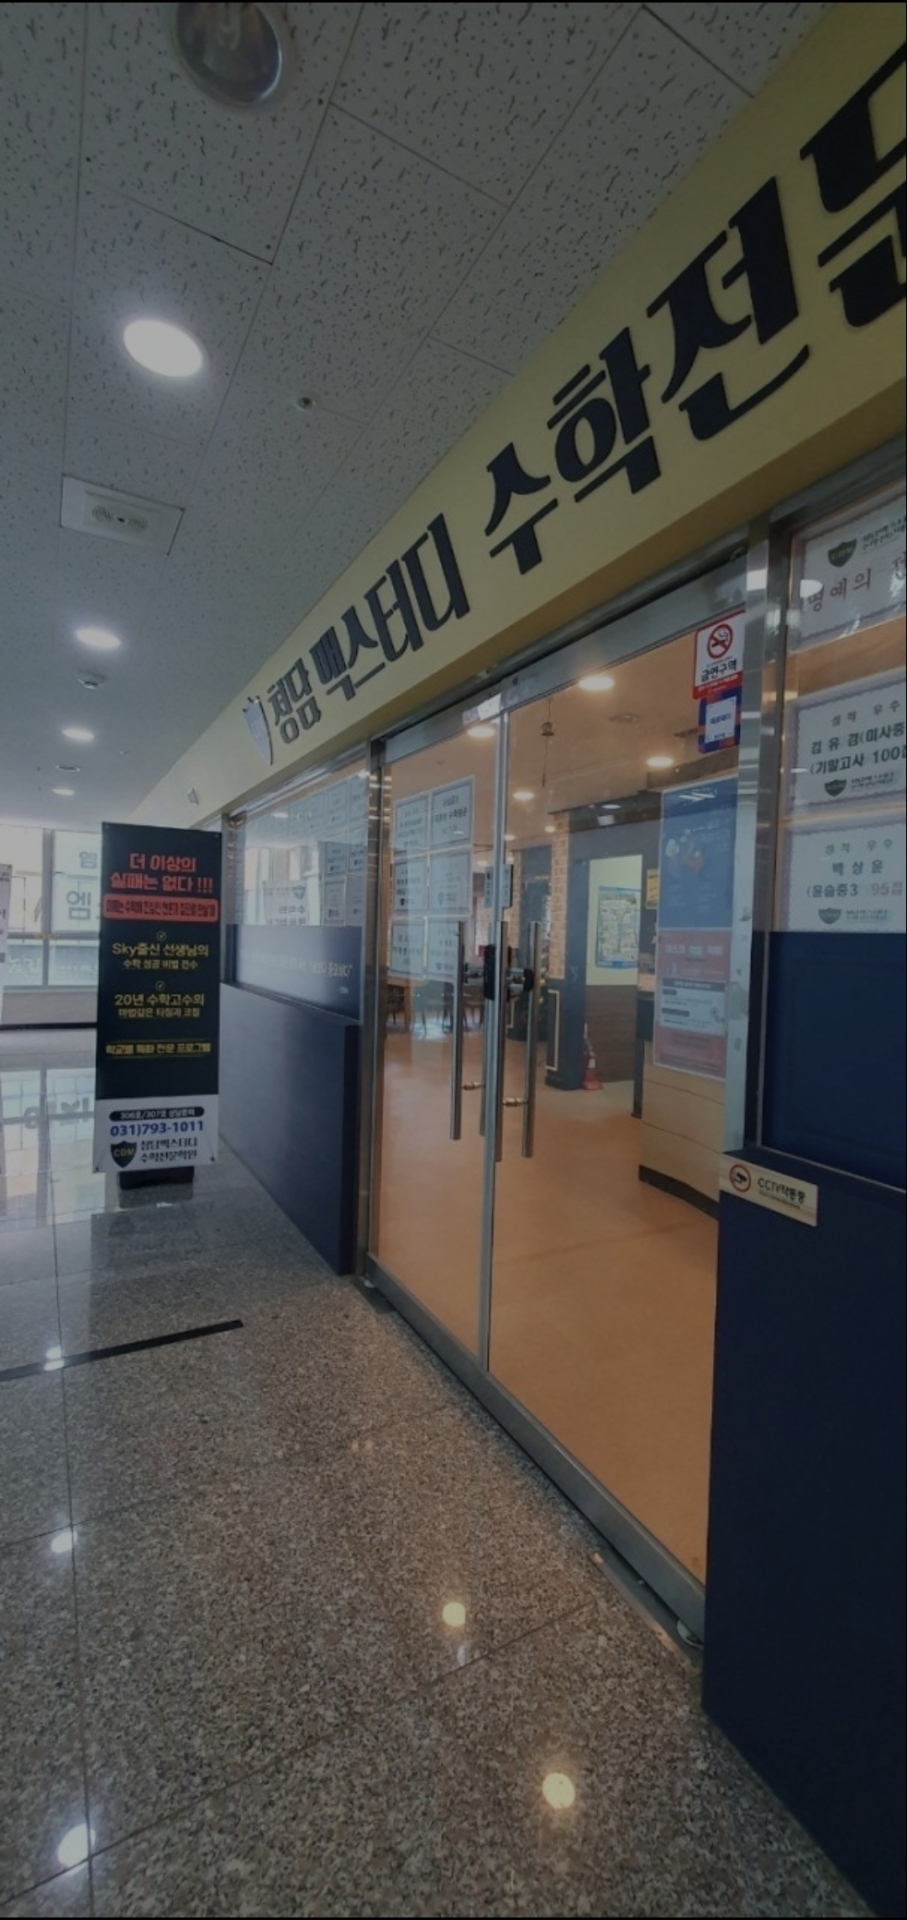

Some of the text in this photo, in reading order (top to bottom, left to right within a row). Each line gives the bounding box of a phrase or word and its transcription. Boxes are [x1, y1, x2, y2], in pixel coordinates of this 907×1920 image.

[701, 658, 737, 682] 금연구역
[810, 753, 865, 775] (기말고사
[129, 853, 197, 873] 더 이상의
[110, 872, 158, 891] 실패는
[162, 873, 194, 892] 없다
[112, 942, 209, 957] Sky출신 선생님의
[123, 959, 198, 970] 수학 성공 비법 전수
[114, 994, 205, 1006] 20년 수학고수의
[110, 1121, 204, 1137] 031)793-1011
[757, 1177, 805, 1204] CCTV작동중
